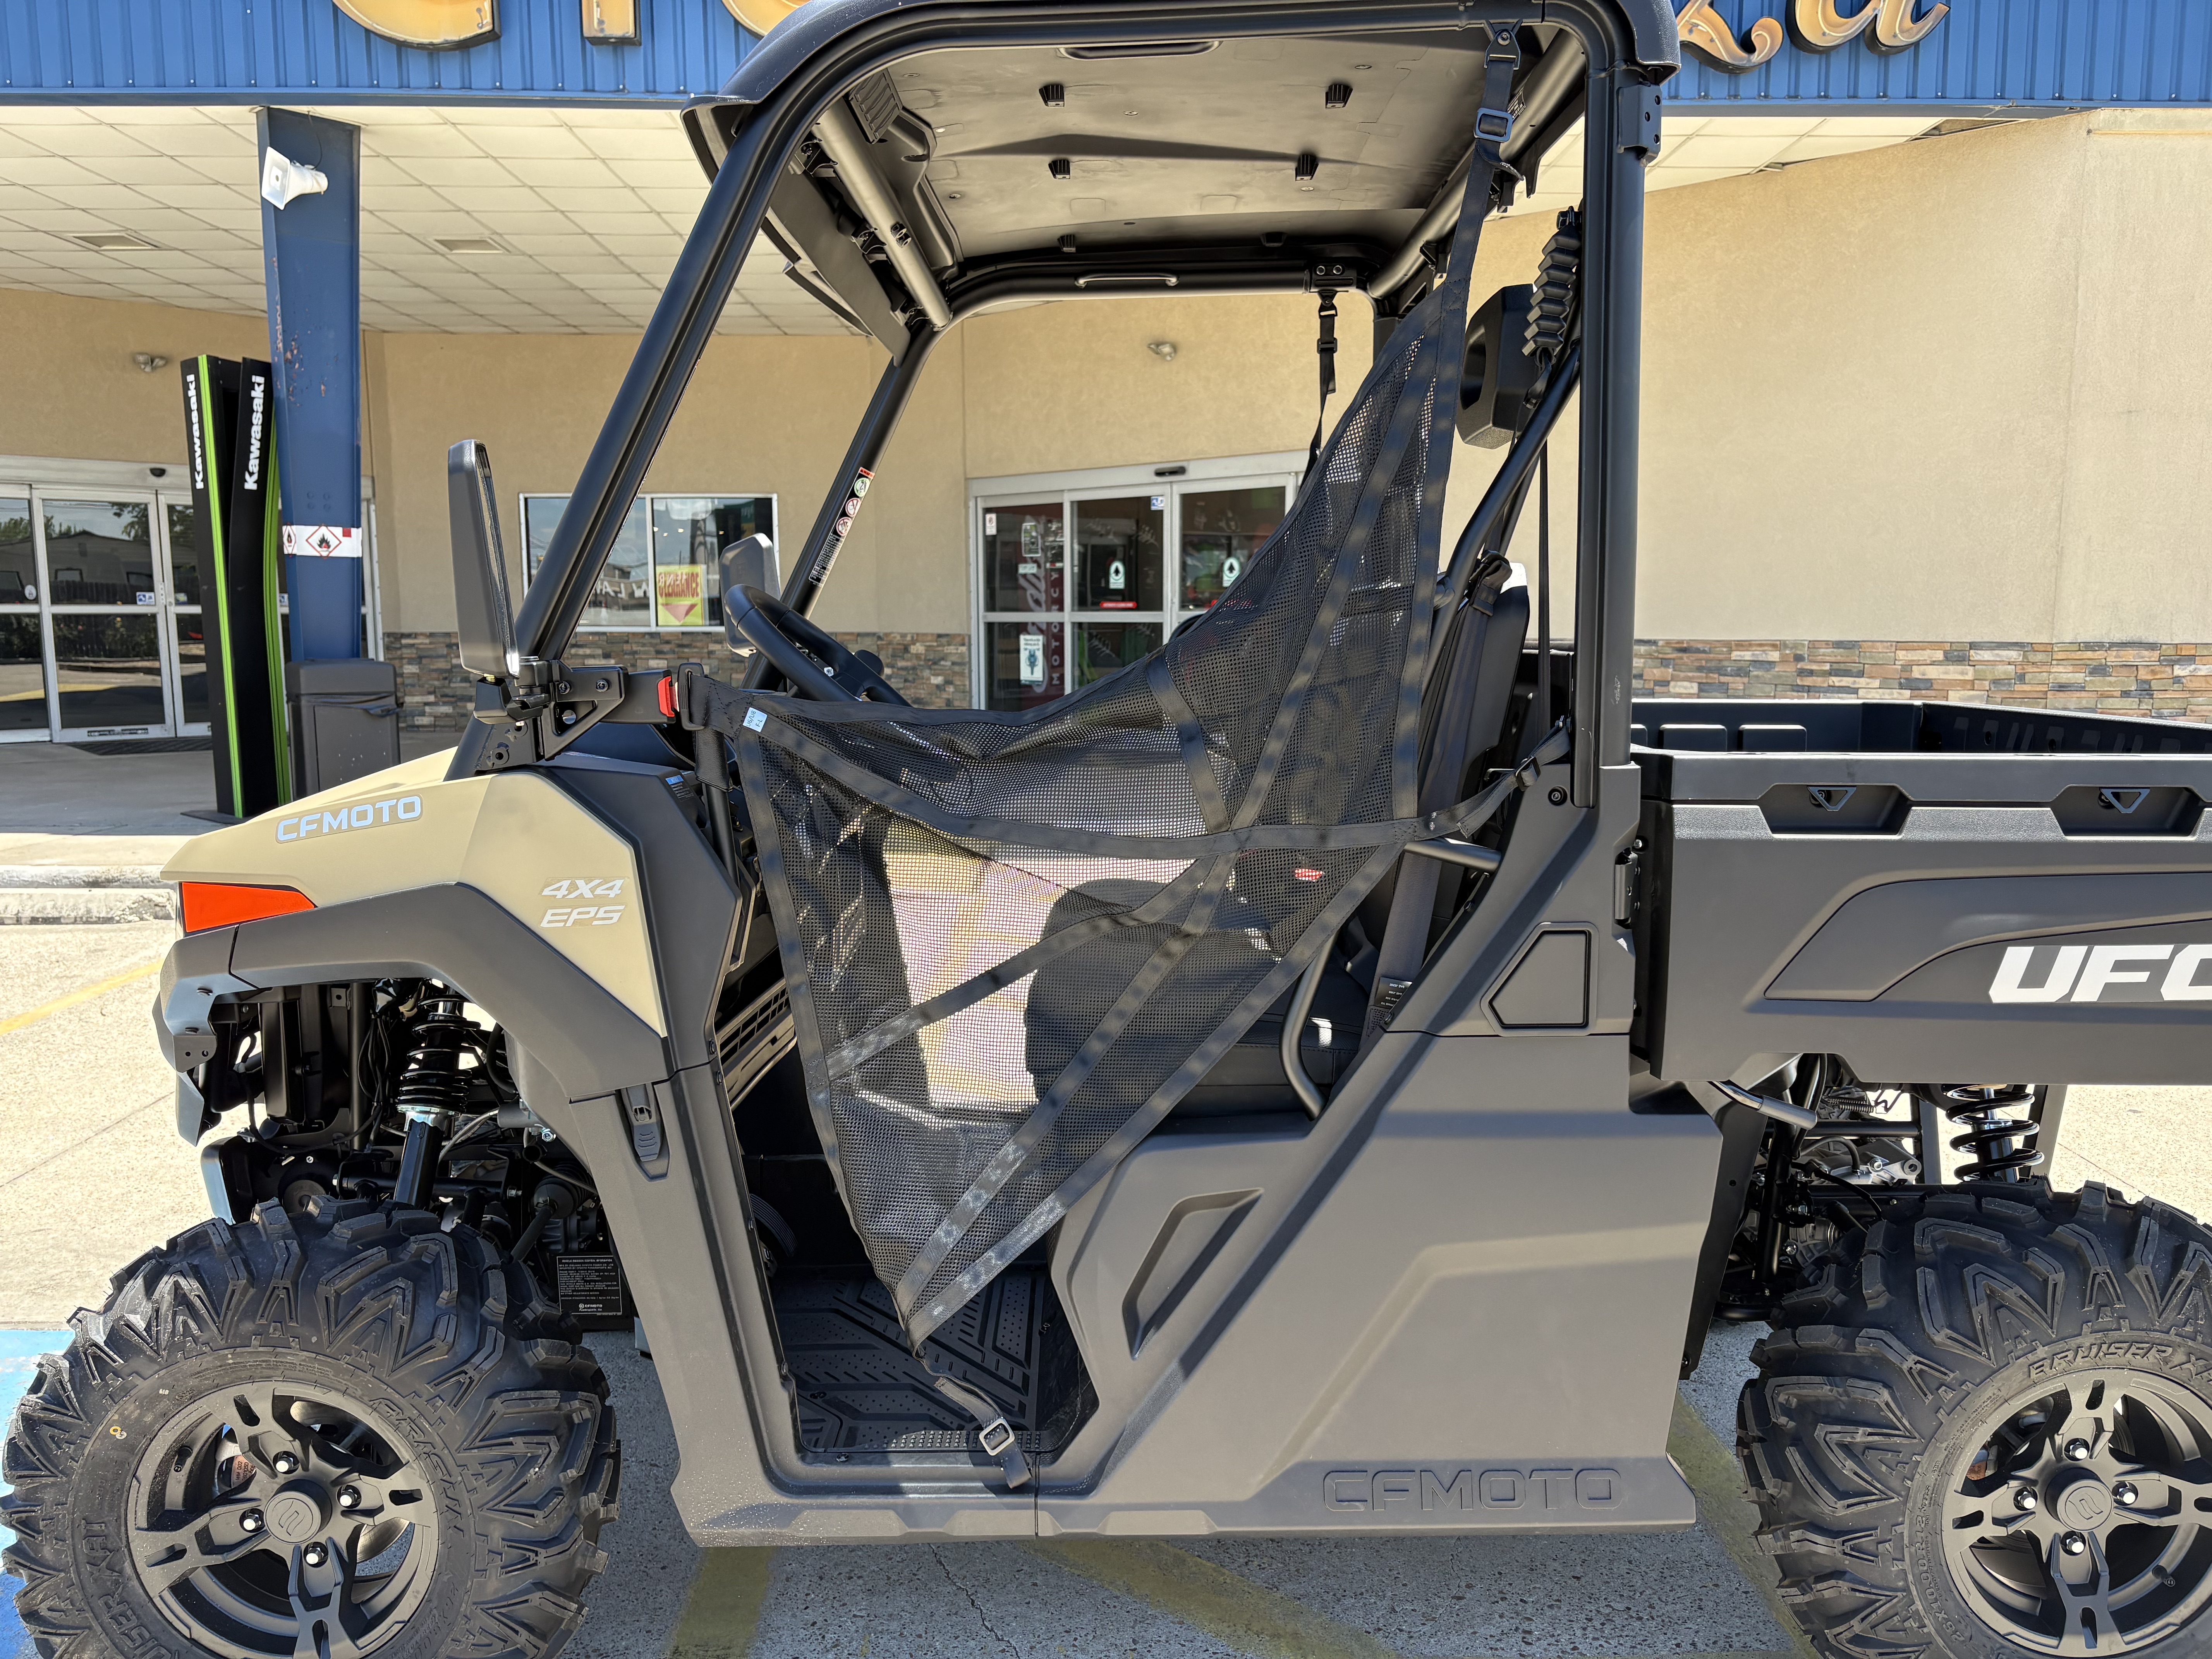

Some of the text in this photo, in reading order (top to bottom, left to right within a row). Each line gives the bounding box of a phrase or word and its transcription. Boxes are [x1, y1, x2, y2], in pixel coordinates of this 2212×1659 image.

[187, 374, 204, 489] Kawasaki
[244, 375, 265, 490] Kawasaki
[746, 710, 756, 727] U6/U8
[276, 796, 422, 842] CFMOTO
[542, 879, 624, 899] 4X4
[540, 905, 625, 927] EPS
[2028, 1342, 2172, 1379] BRUISER
[1323, 1468, 1621, 1511] CFMOTO
[81, 1518, 121, 1583] XAT
